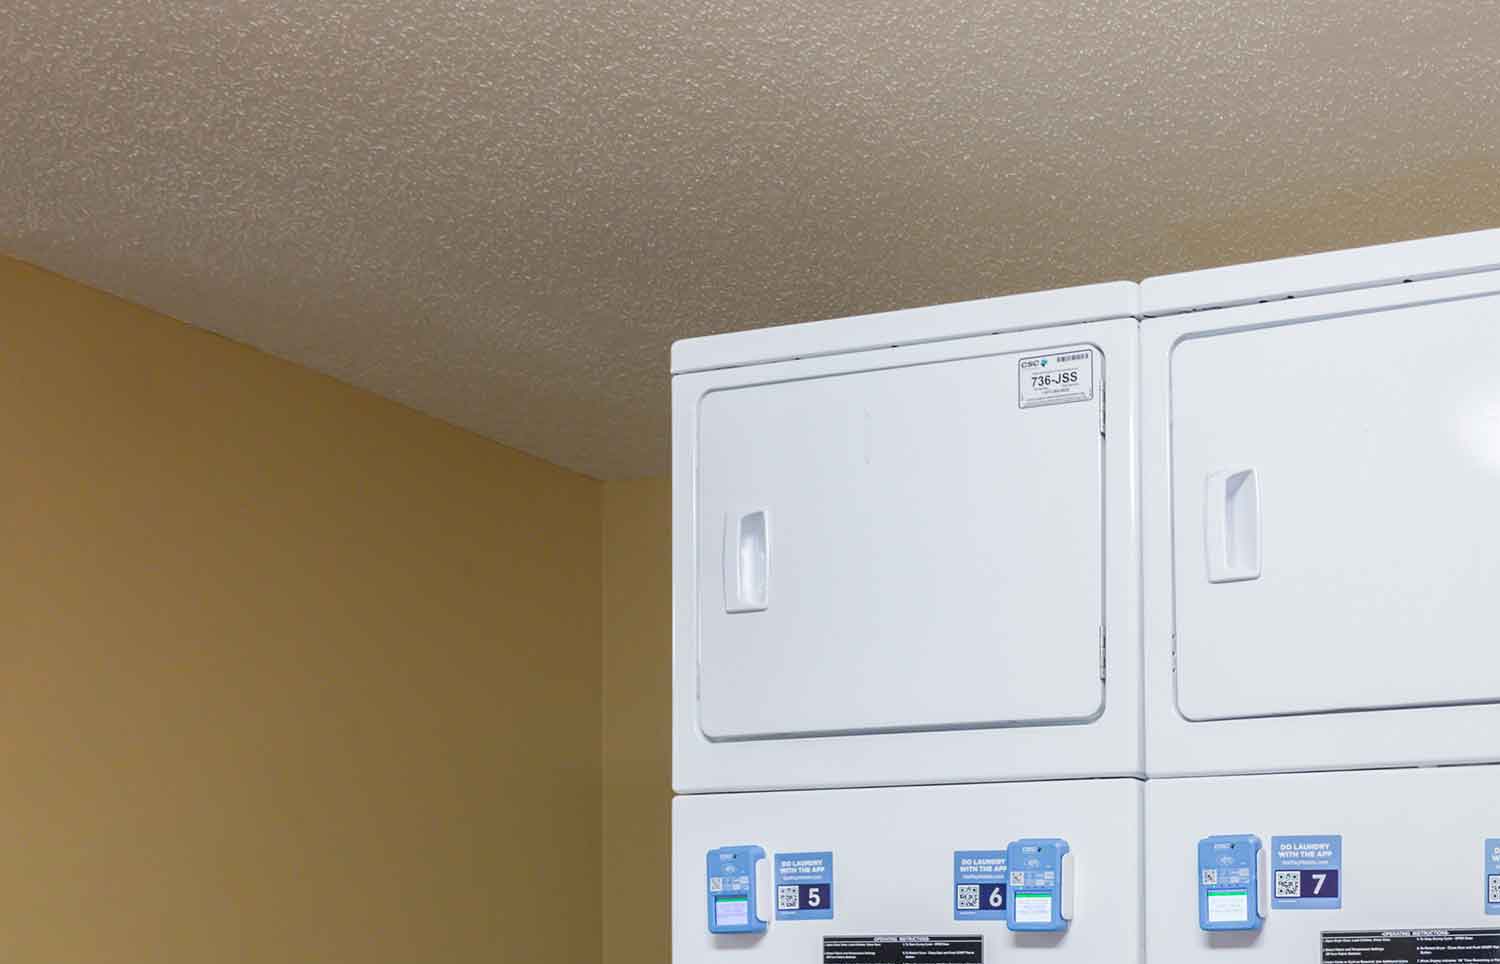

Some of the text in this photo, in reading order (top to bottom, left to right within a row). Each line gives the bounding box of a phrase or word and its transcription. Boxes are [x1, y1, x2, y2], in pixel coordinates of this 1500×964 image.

[1032, 371, 1078, 387] 736-JSS
[1311, 873, 1327, 895] 7
[808, 888, 821, 907] 5
[989, 887, 1003, 907] 6
